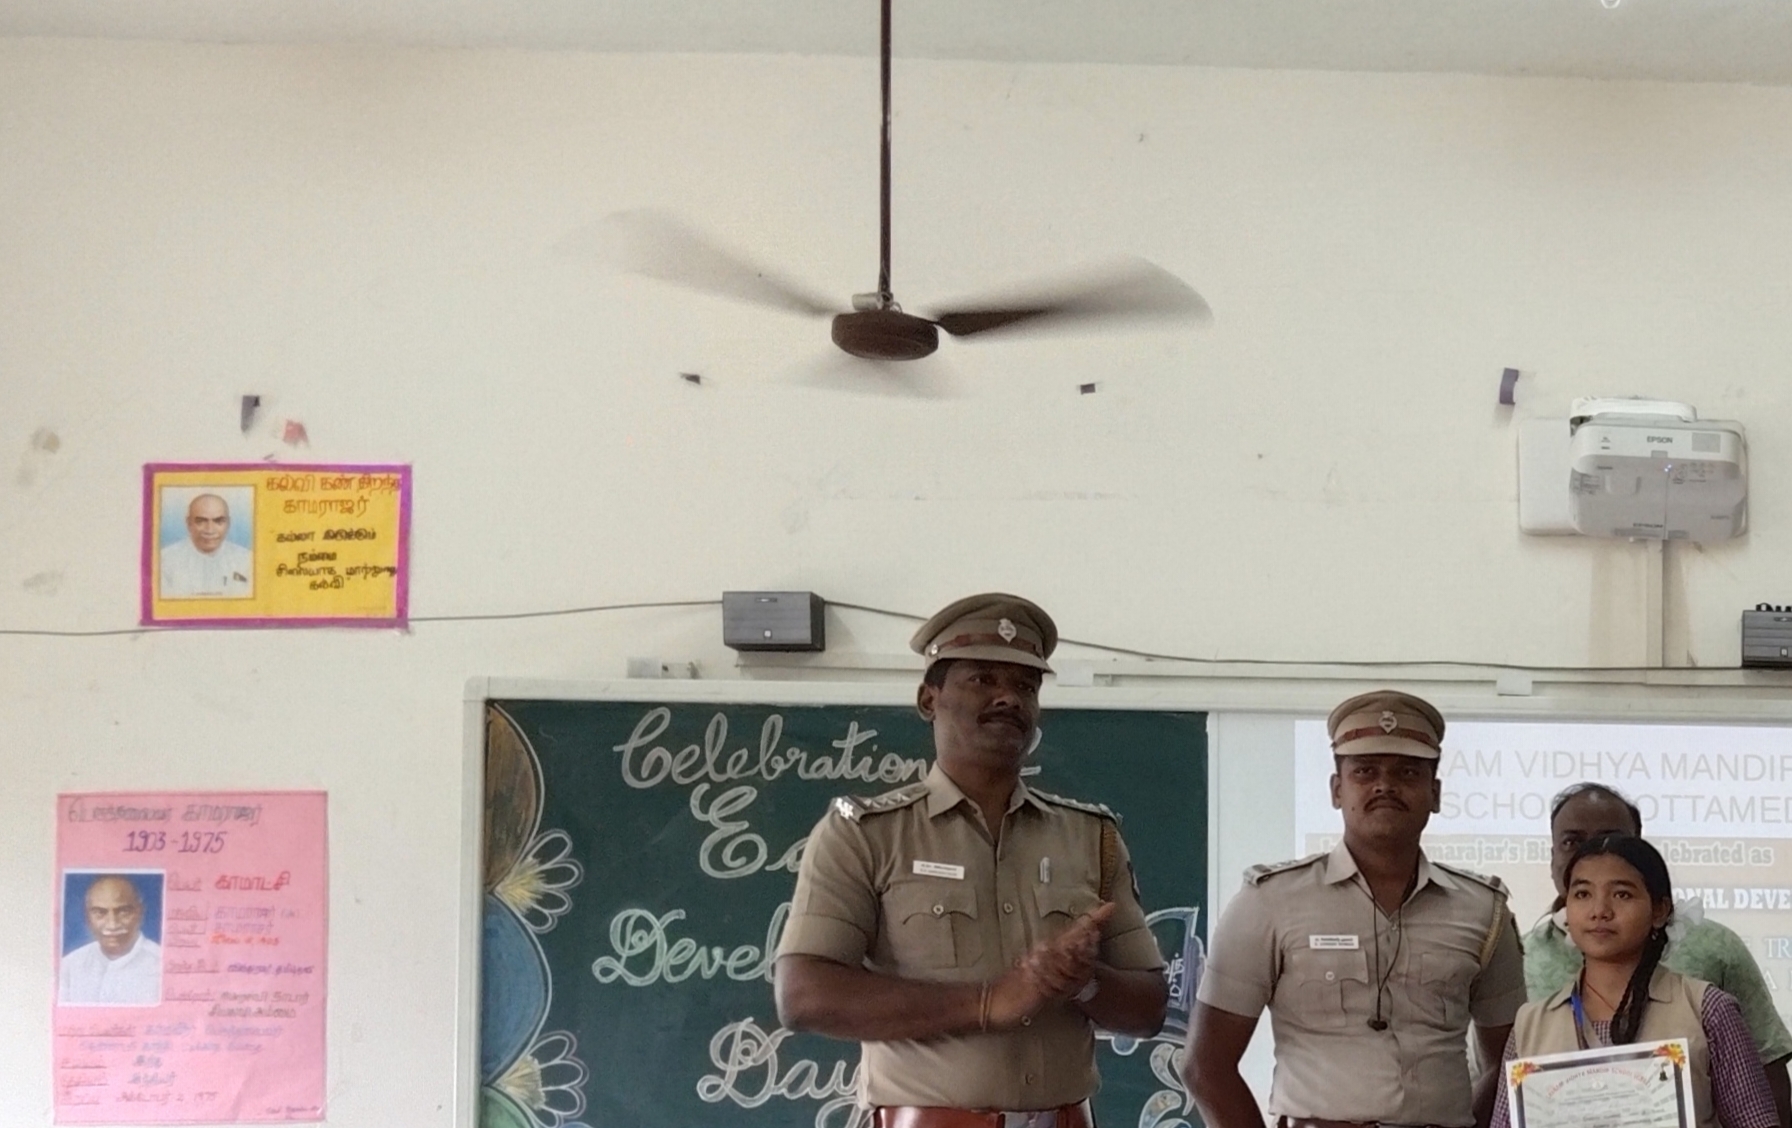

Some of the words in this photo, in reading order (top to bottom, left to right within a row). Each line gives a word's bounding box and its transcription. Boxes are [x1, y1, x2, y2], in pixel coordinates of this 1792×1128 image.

[613, 707, 927, 788] Celebration
[1435, 750, 1502, 778] AM
[1514, 751, 1651, 780] VIDHYA
[1440, 792, 1552, 820] SCHO
[1625, 794, 1792, 823] OTTAME
[1661, 842, 1744, 865] lebrated
[1750, 847, 1773, 865] as
[1672, 888, 1730, 909] ONAL
[1733, 887, 1792, 909] DEVE
